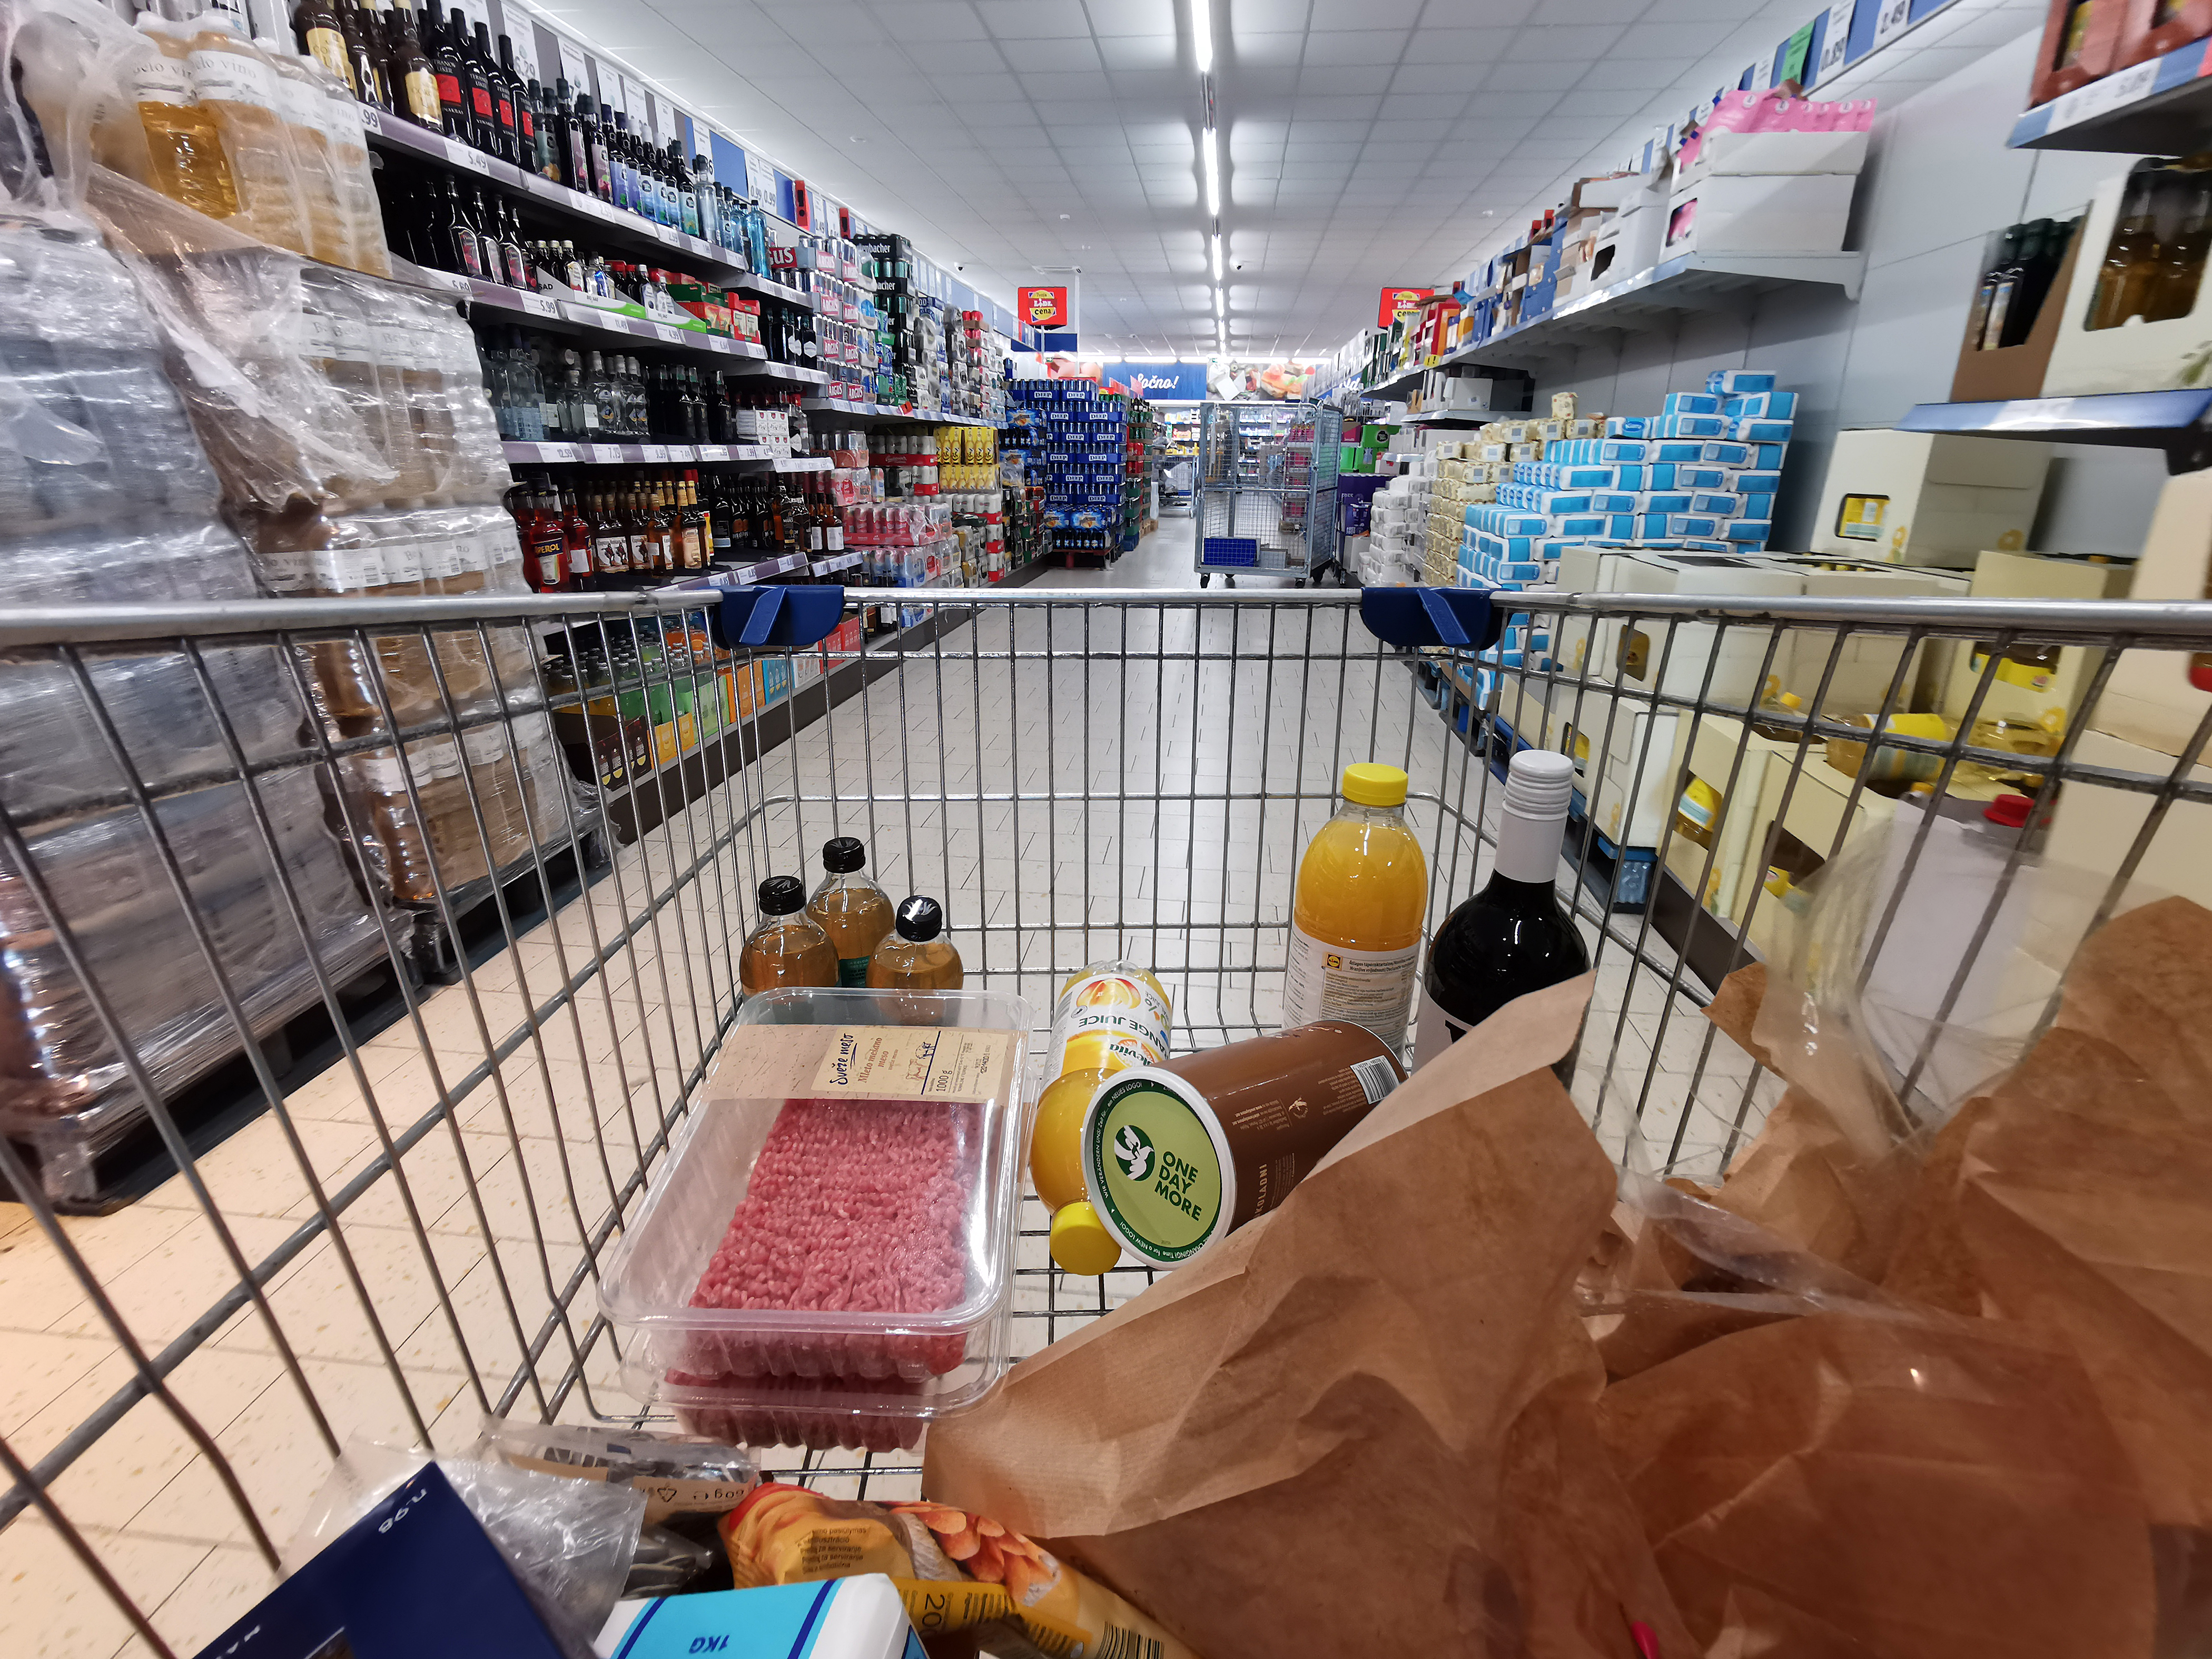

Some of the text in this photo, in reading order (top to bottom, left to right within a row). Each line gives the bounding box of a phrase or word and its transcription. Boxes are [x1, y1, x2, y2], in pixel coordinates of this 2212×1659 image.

[468, 151, 487, 169] 5.49
[540, 299, 556, 314] 5.99
[1034, 299, 1053, 308] LIDL
[1078, 1015, 1127, 1028] JUICE
[841, 1032, 854, 1055] meso
[878, 1050, 889, 1068] meso
[858, 1062, 873, 1084] Mleto
[935, 1076, 949, 1092] 1000
[1162, 1151, 1199, 1183] ONE
[1159, 1165, 1192, 1194] DAY
[1253, 1163, 1268, 1216] KOLADNI
[1154, 1180, 1202, 1222] MORE
[1135, 1238, 1149, 1250] NEW
[688, 1634, 730, 1654] 1KG
